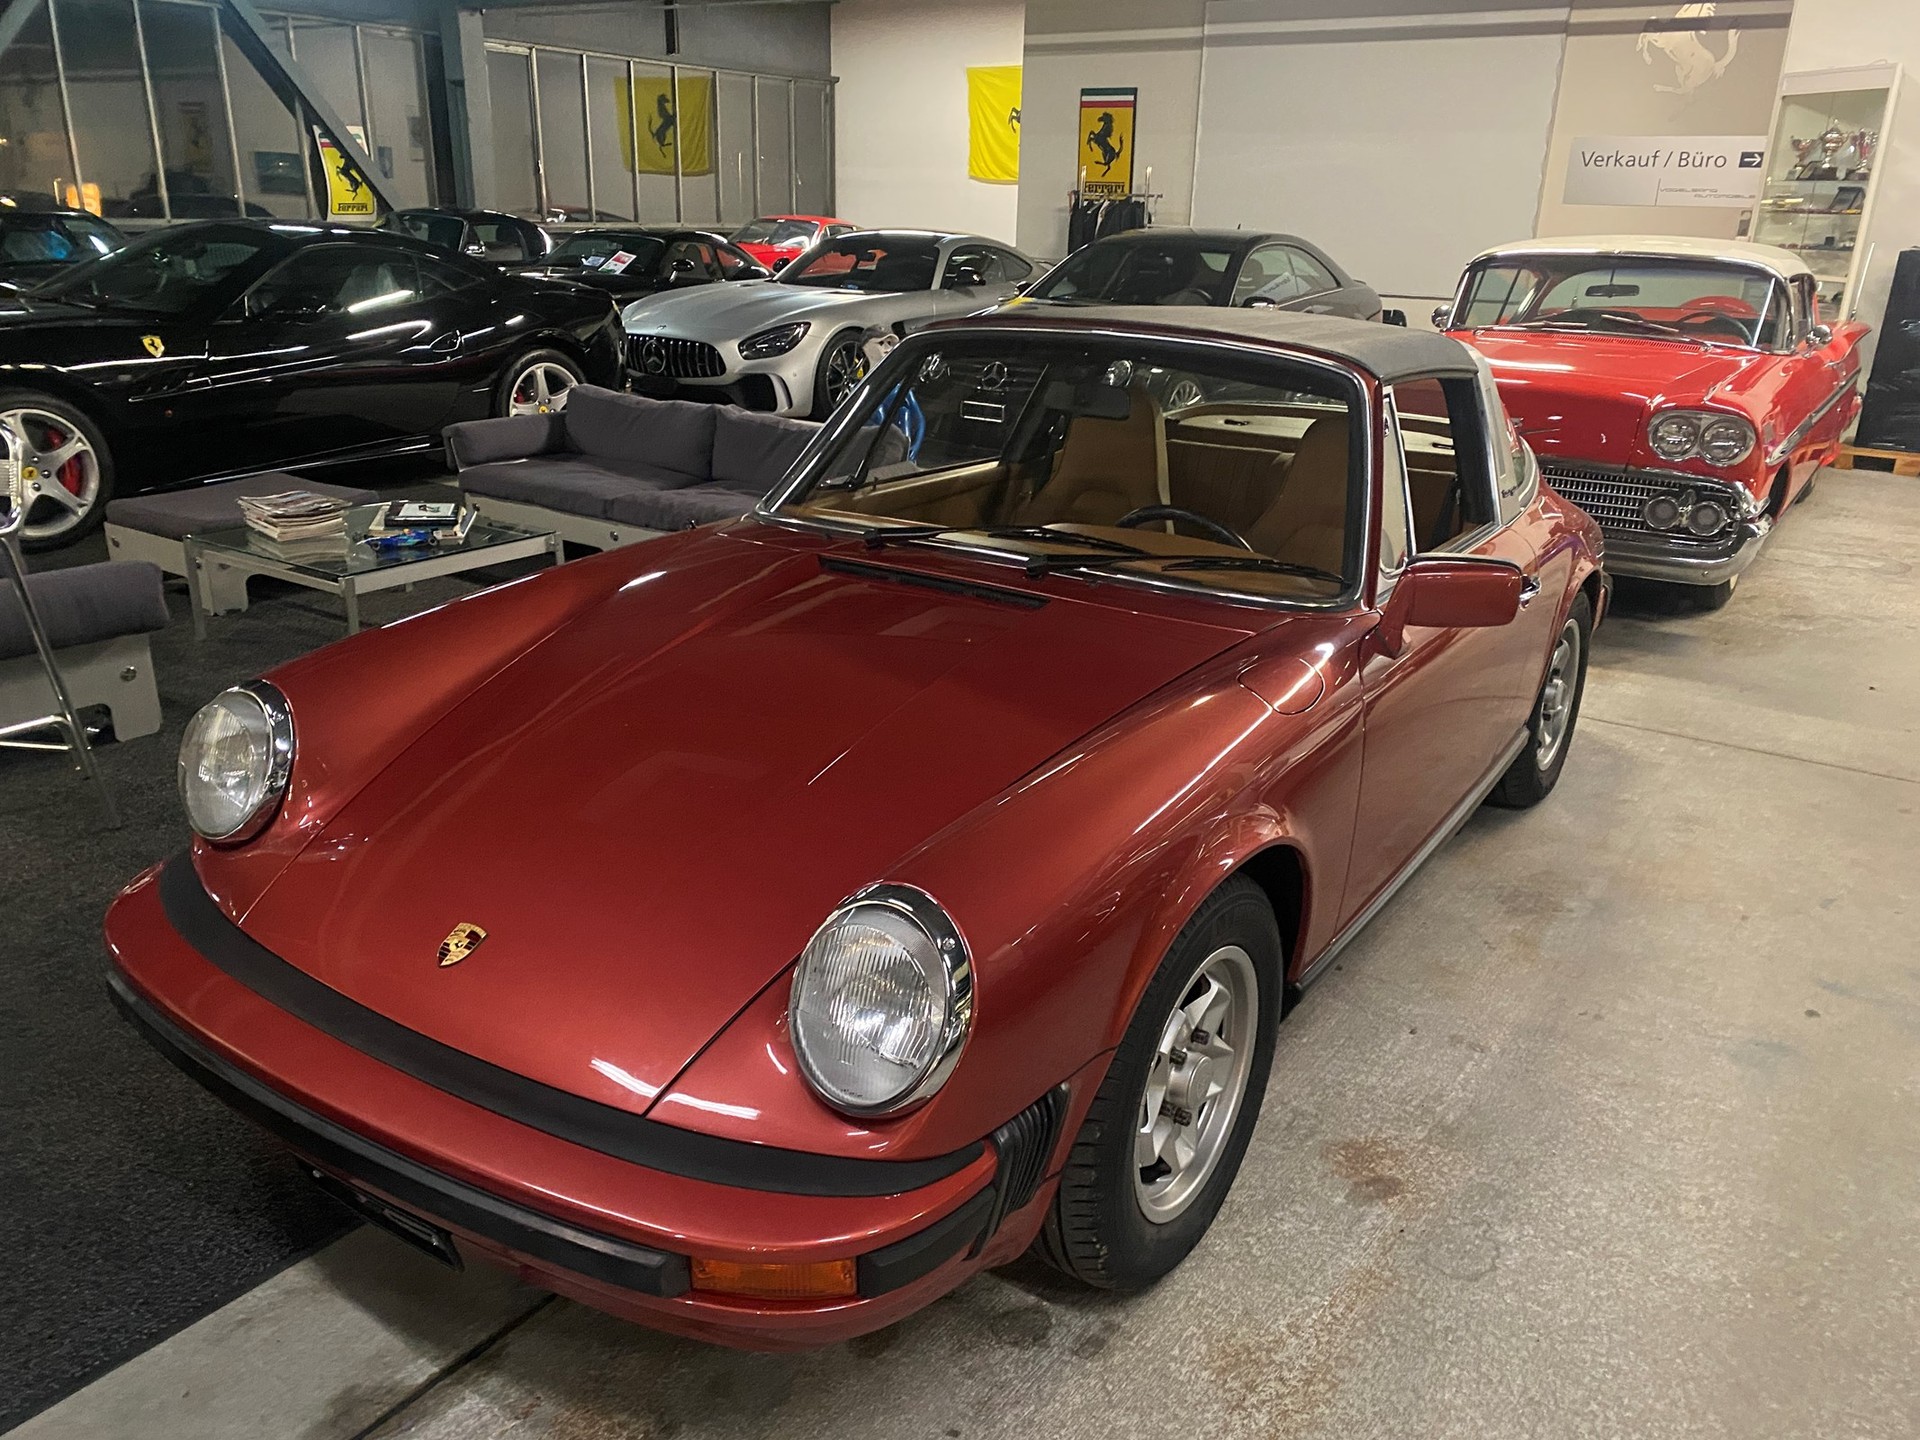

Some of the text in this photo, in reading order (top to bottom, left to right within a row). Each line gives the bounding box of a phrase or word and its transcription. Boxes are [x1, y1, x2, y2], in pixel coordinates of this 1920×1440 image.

[1582, 150, 1727, 168] Verkauf / Büro
